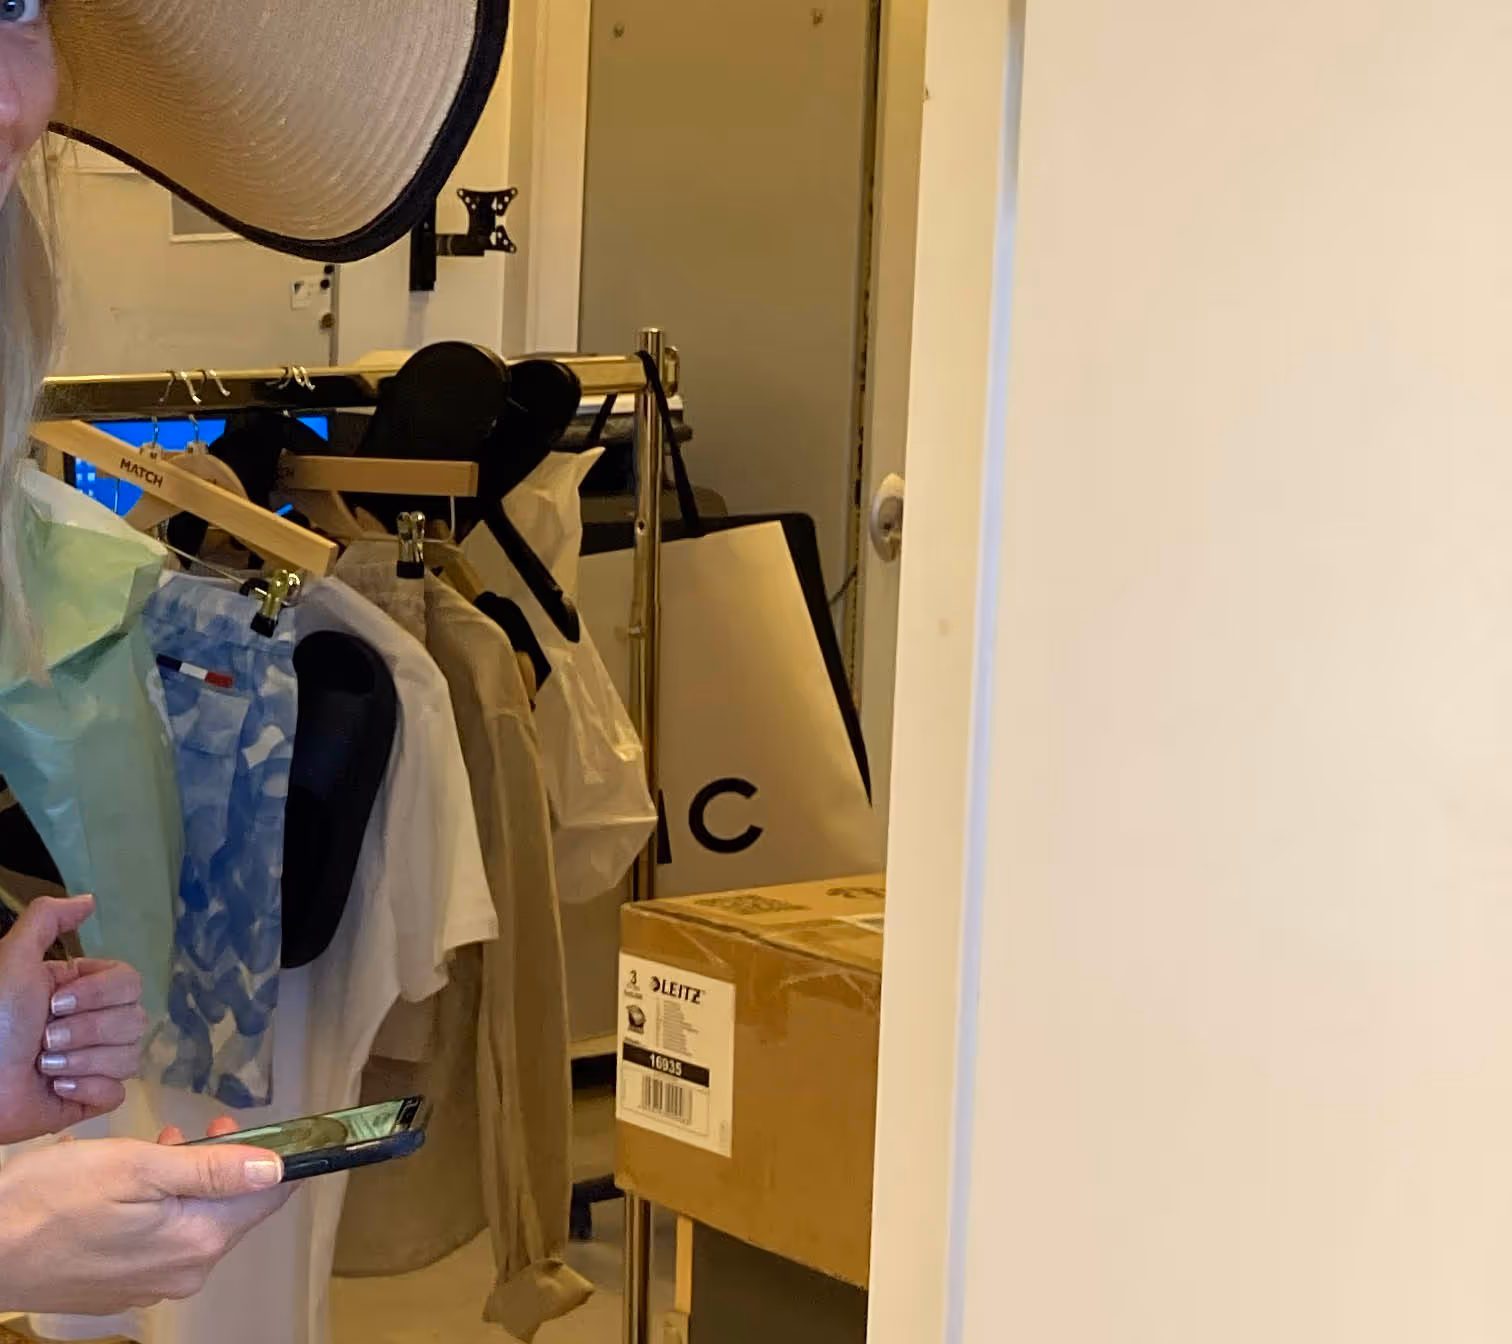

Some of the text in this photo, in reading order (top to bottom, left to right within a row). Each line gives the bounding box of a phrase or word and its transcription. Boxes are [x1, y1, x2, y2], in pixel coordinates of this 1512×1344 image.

[120, 458, 163, 489] MATCH
[629, 969, 638, 985] 3
[661, 978, 701, 1004] LEITZ
